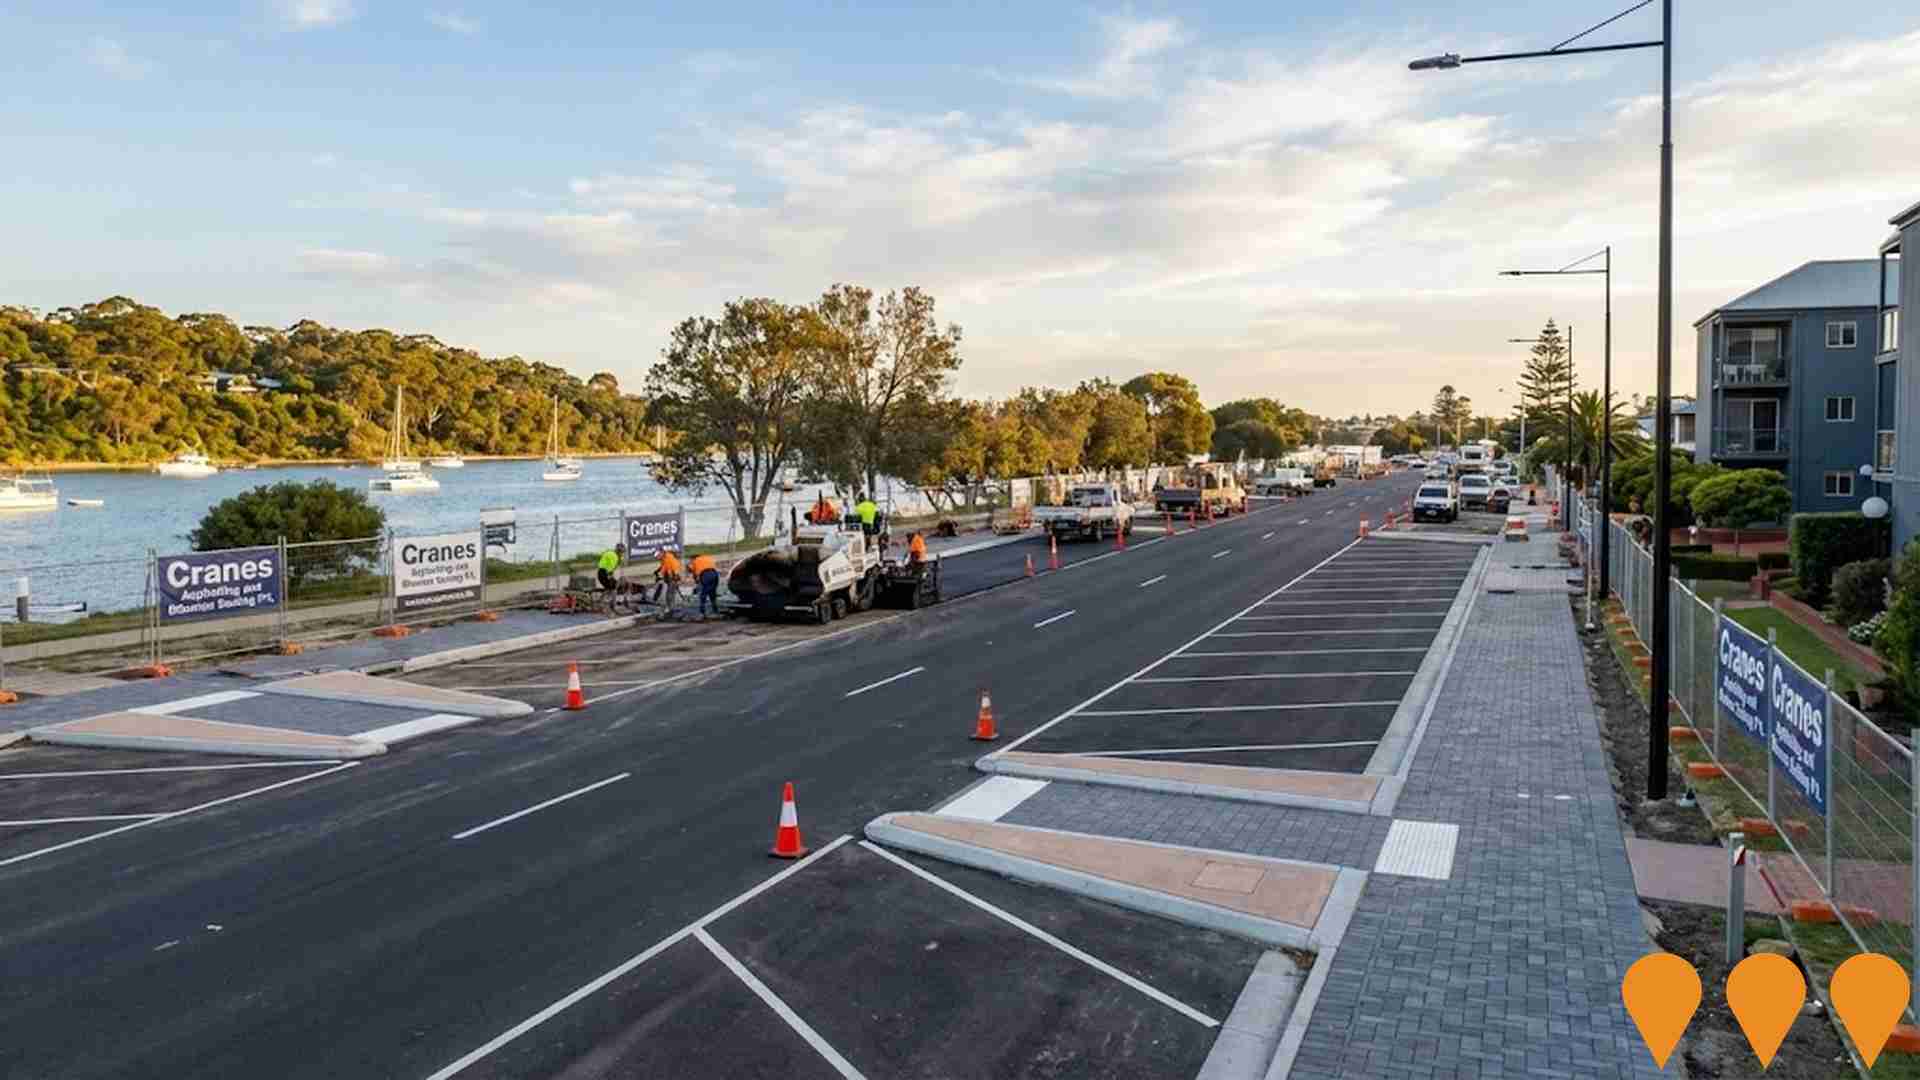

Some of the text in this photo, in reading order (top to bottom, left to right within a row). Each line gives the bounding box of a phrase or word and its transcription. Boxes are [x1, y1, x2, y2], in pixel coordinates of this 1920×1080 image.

[167, 559, 273, 588] Cranes
[402, 542, 476, 565] Cranes
[1720, 629, 1765, 692] Cranes
[1772, 664, 1822, 747] Cranes
